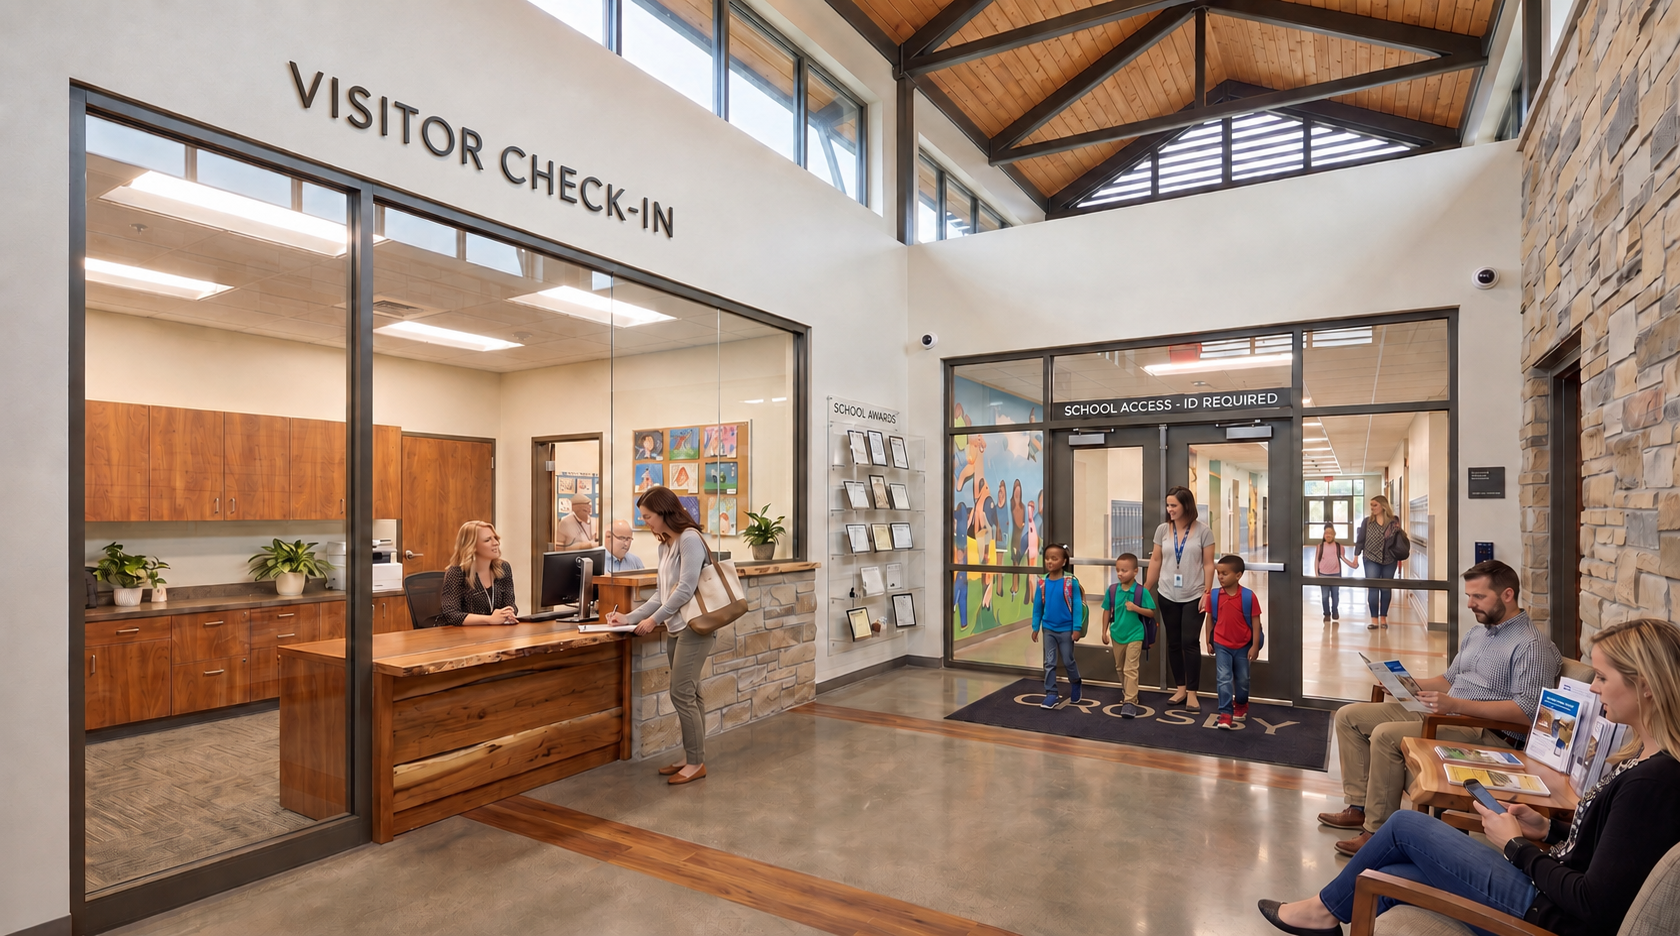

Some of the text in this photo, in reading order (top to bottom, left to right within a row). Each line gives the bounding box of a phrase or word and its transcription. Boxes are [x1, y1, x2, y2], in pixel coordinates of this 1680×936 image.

[288, 60, 675, 239] VISITOR CHECK-IN
[834, 403, 896, 424] SCHOOL AWARDS
[1064, 403, 1117, 417] SCHOOL
[1120, 399, 1172, 413] ACCESS
[1184, 397, 1198, 409] ID
[1203, 393, 1278, 408] REQUIRED
